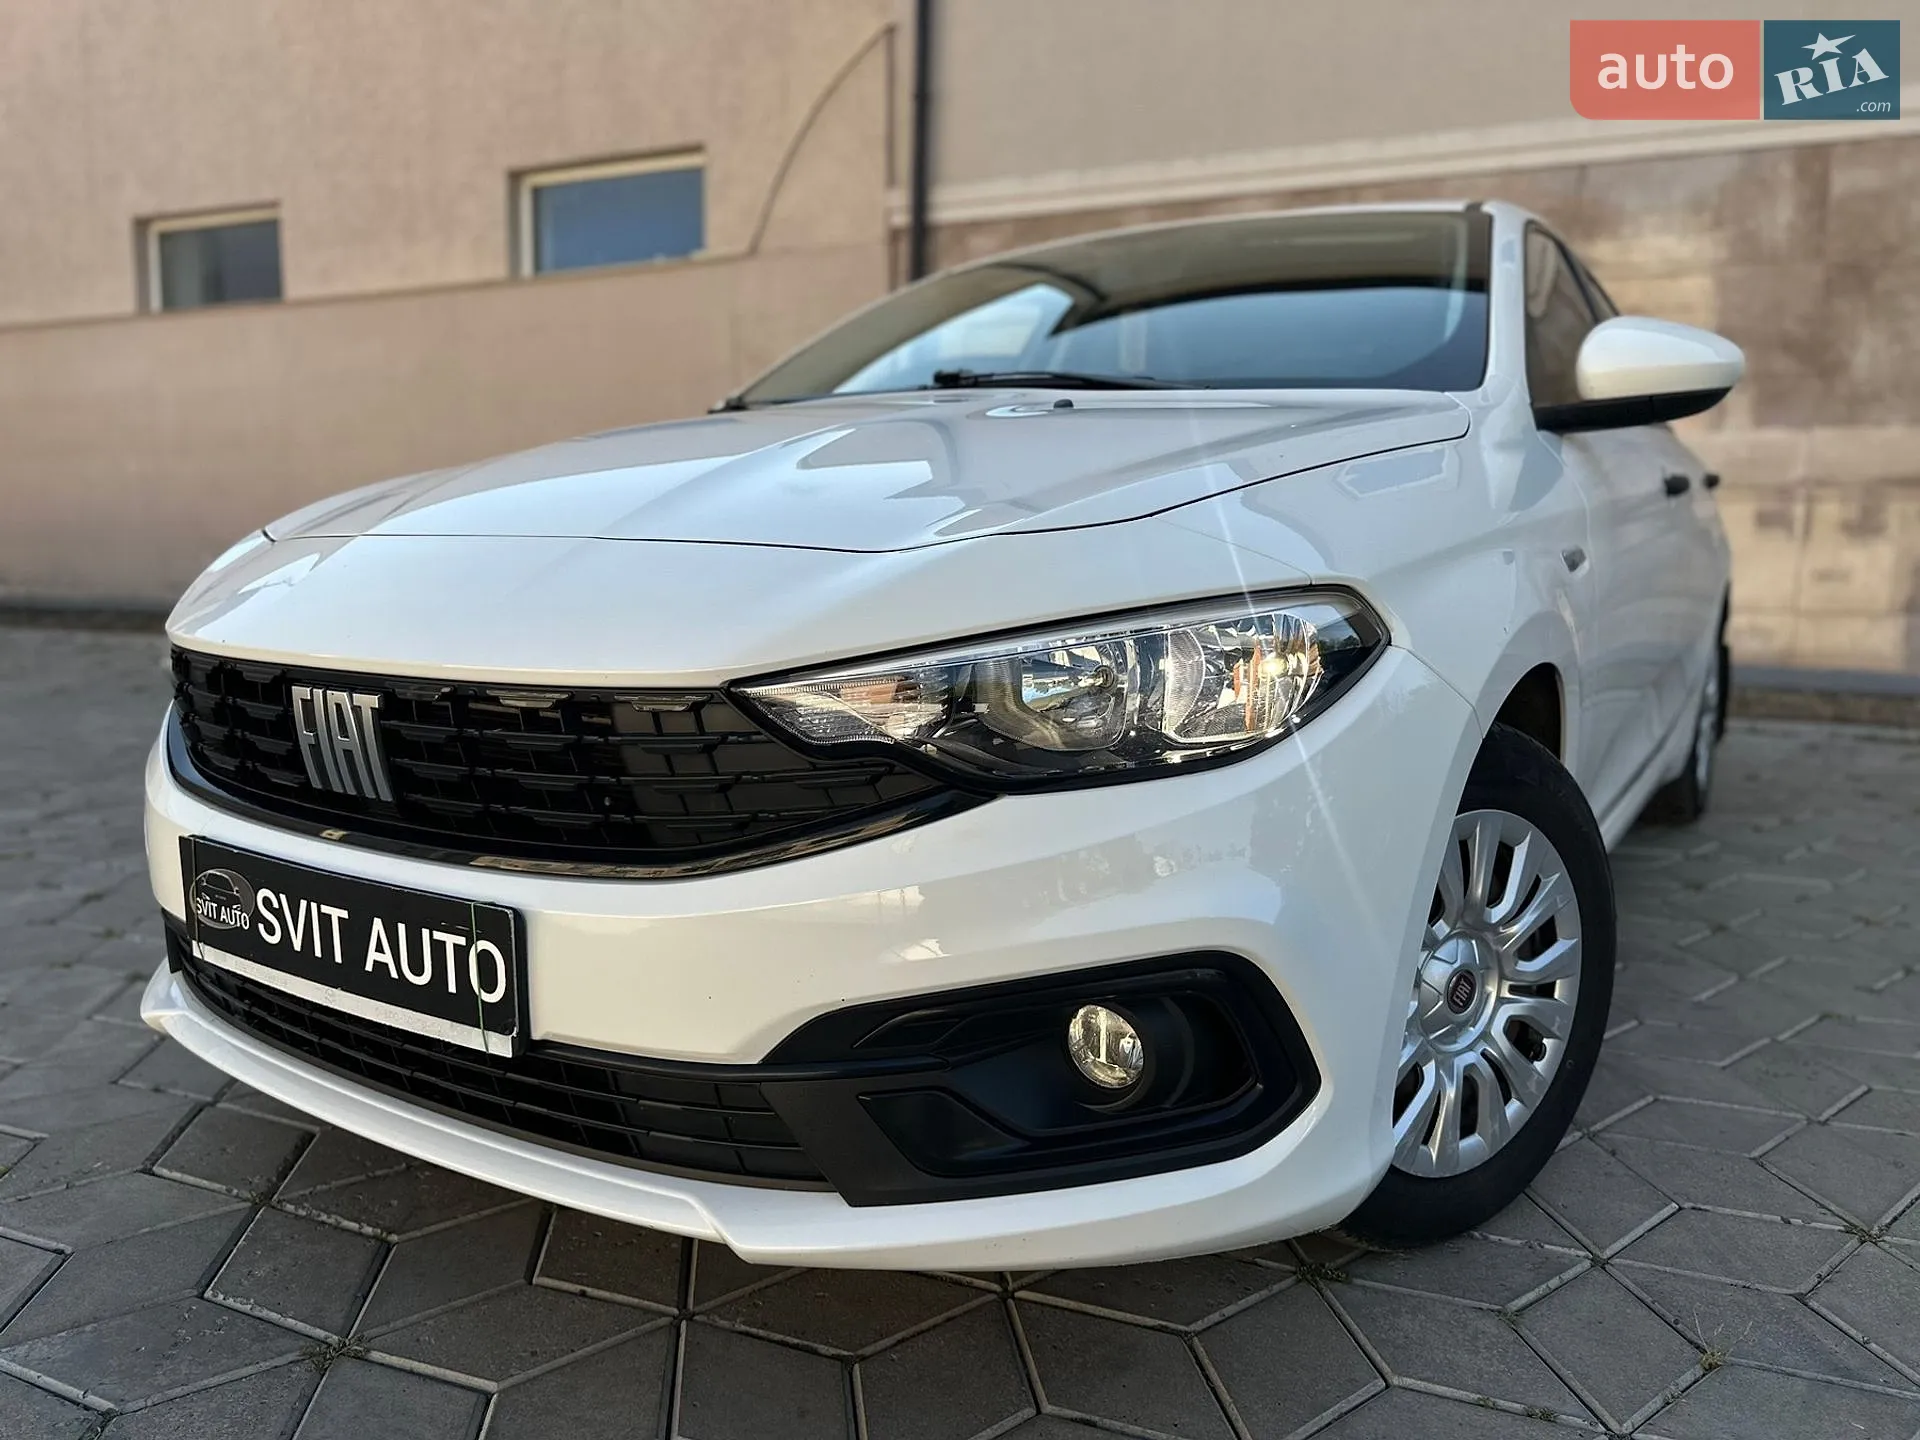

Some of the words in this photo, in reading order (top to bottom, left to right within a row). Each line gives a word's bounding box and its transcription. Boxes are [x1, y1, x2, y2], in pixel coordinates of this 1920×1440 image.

[292, 685, 393, 802] FIAT
[196, 897, 217, 919] SVIT
[220, 905, 249, 930] AUTO
[256, 888, 349, 965] SVIT
[365, 917, 506, 1004] AUTO
[1453, 978, 1471, 1006] FIAT
